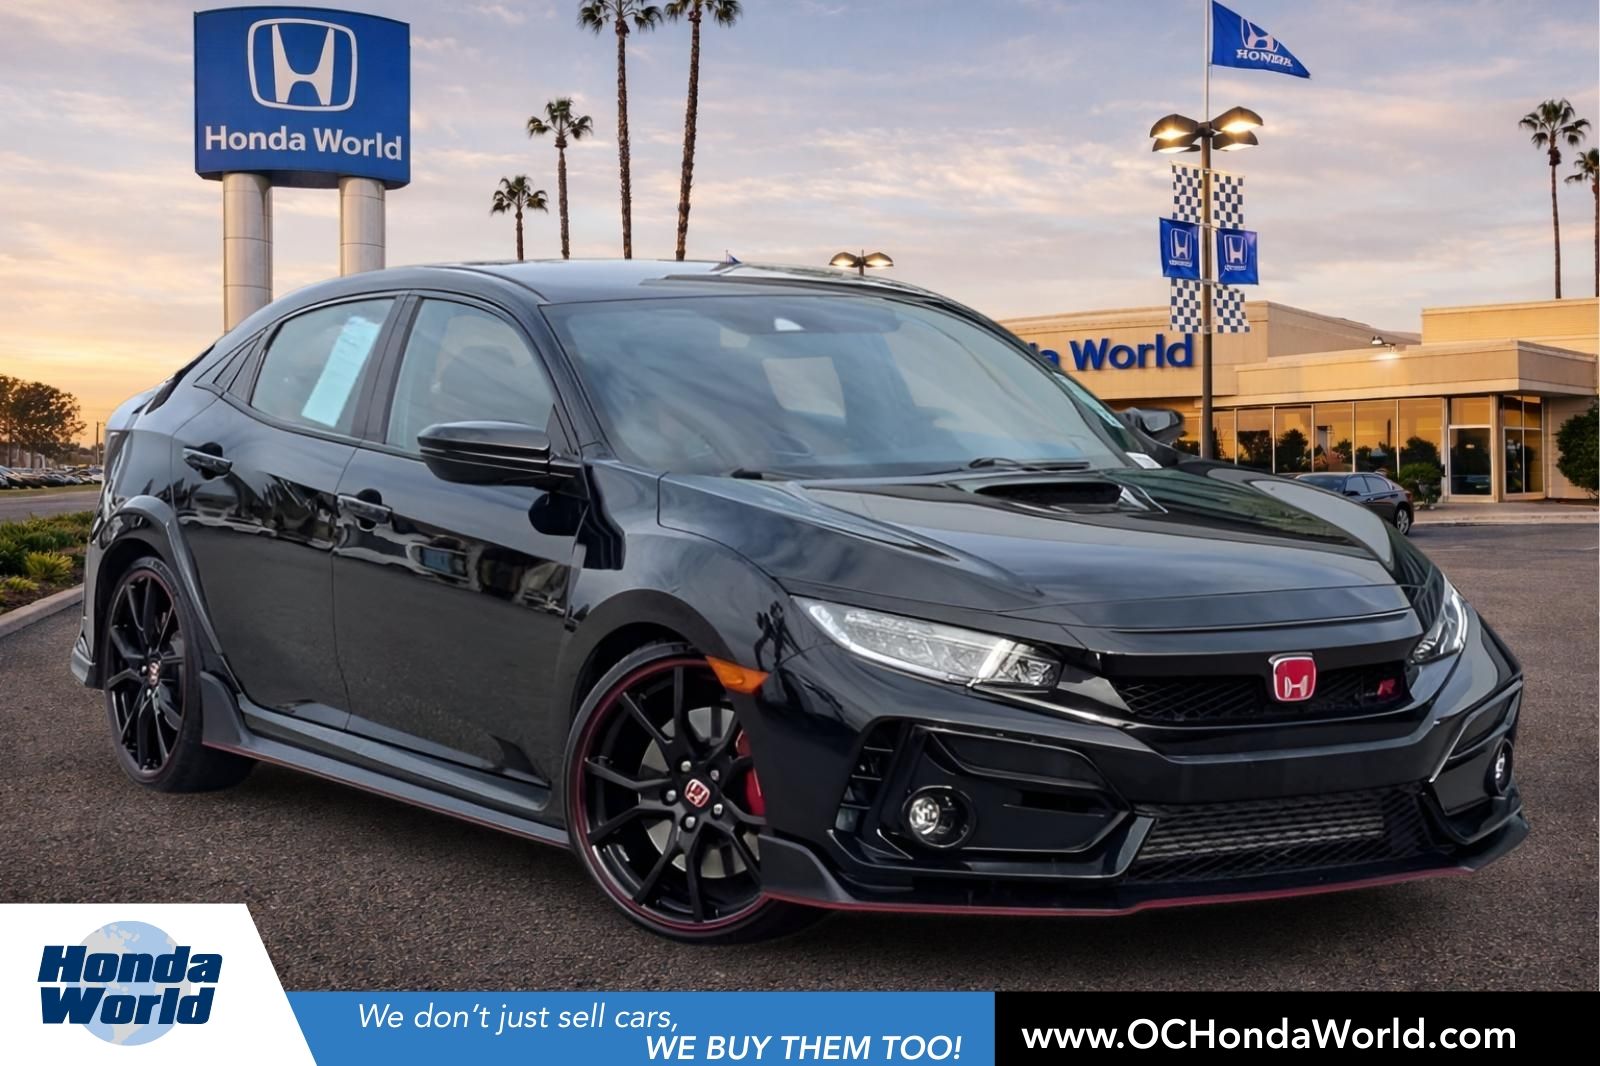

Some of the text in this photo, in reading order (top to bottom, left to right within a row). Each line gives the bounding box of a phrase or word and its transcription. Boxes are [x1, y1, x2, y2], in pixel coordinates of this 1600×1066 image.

[205, 125, 402, 160] Honda World
[1069, 334, 1193, 371] World
